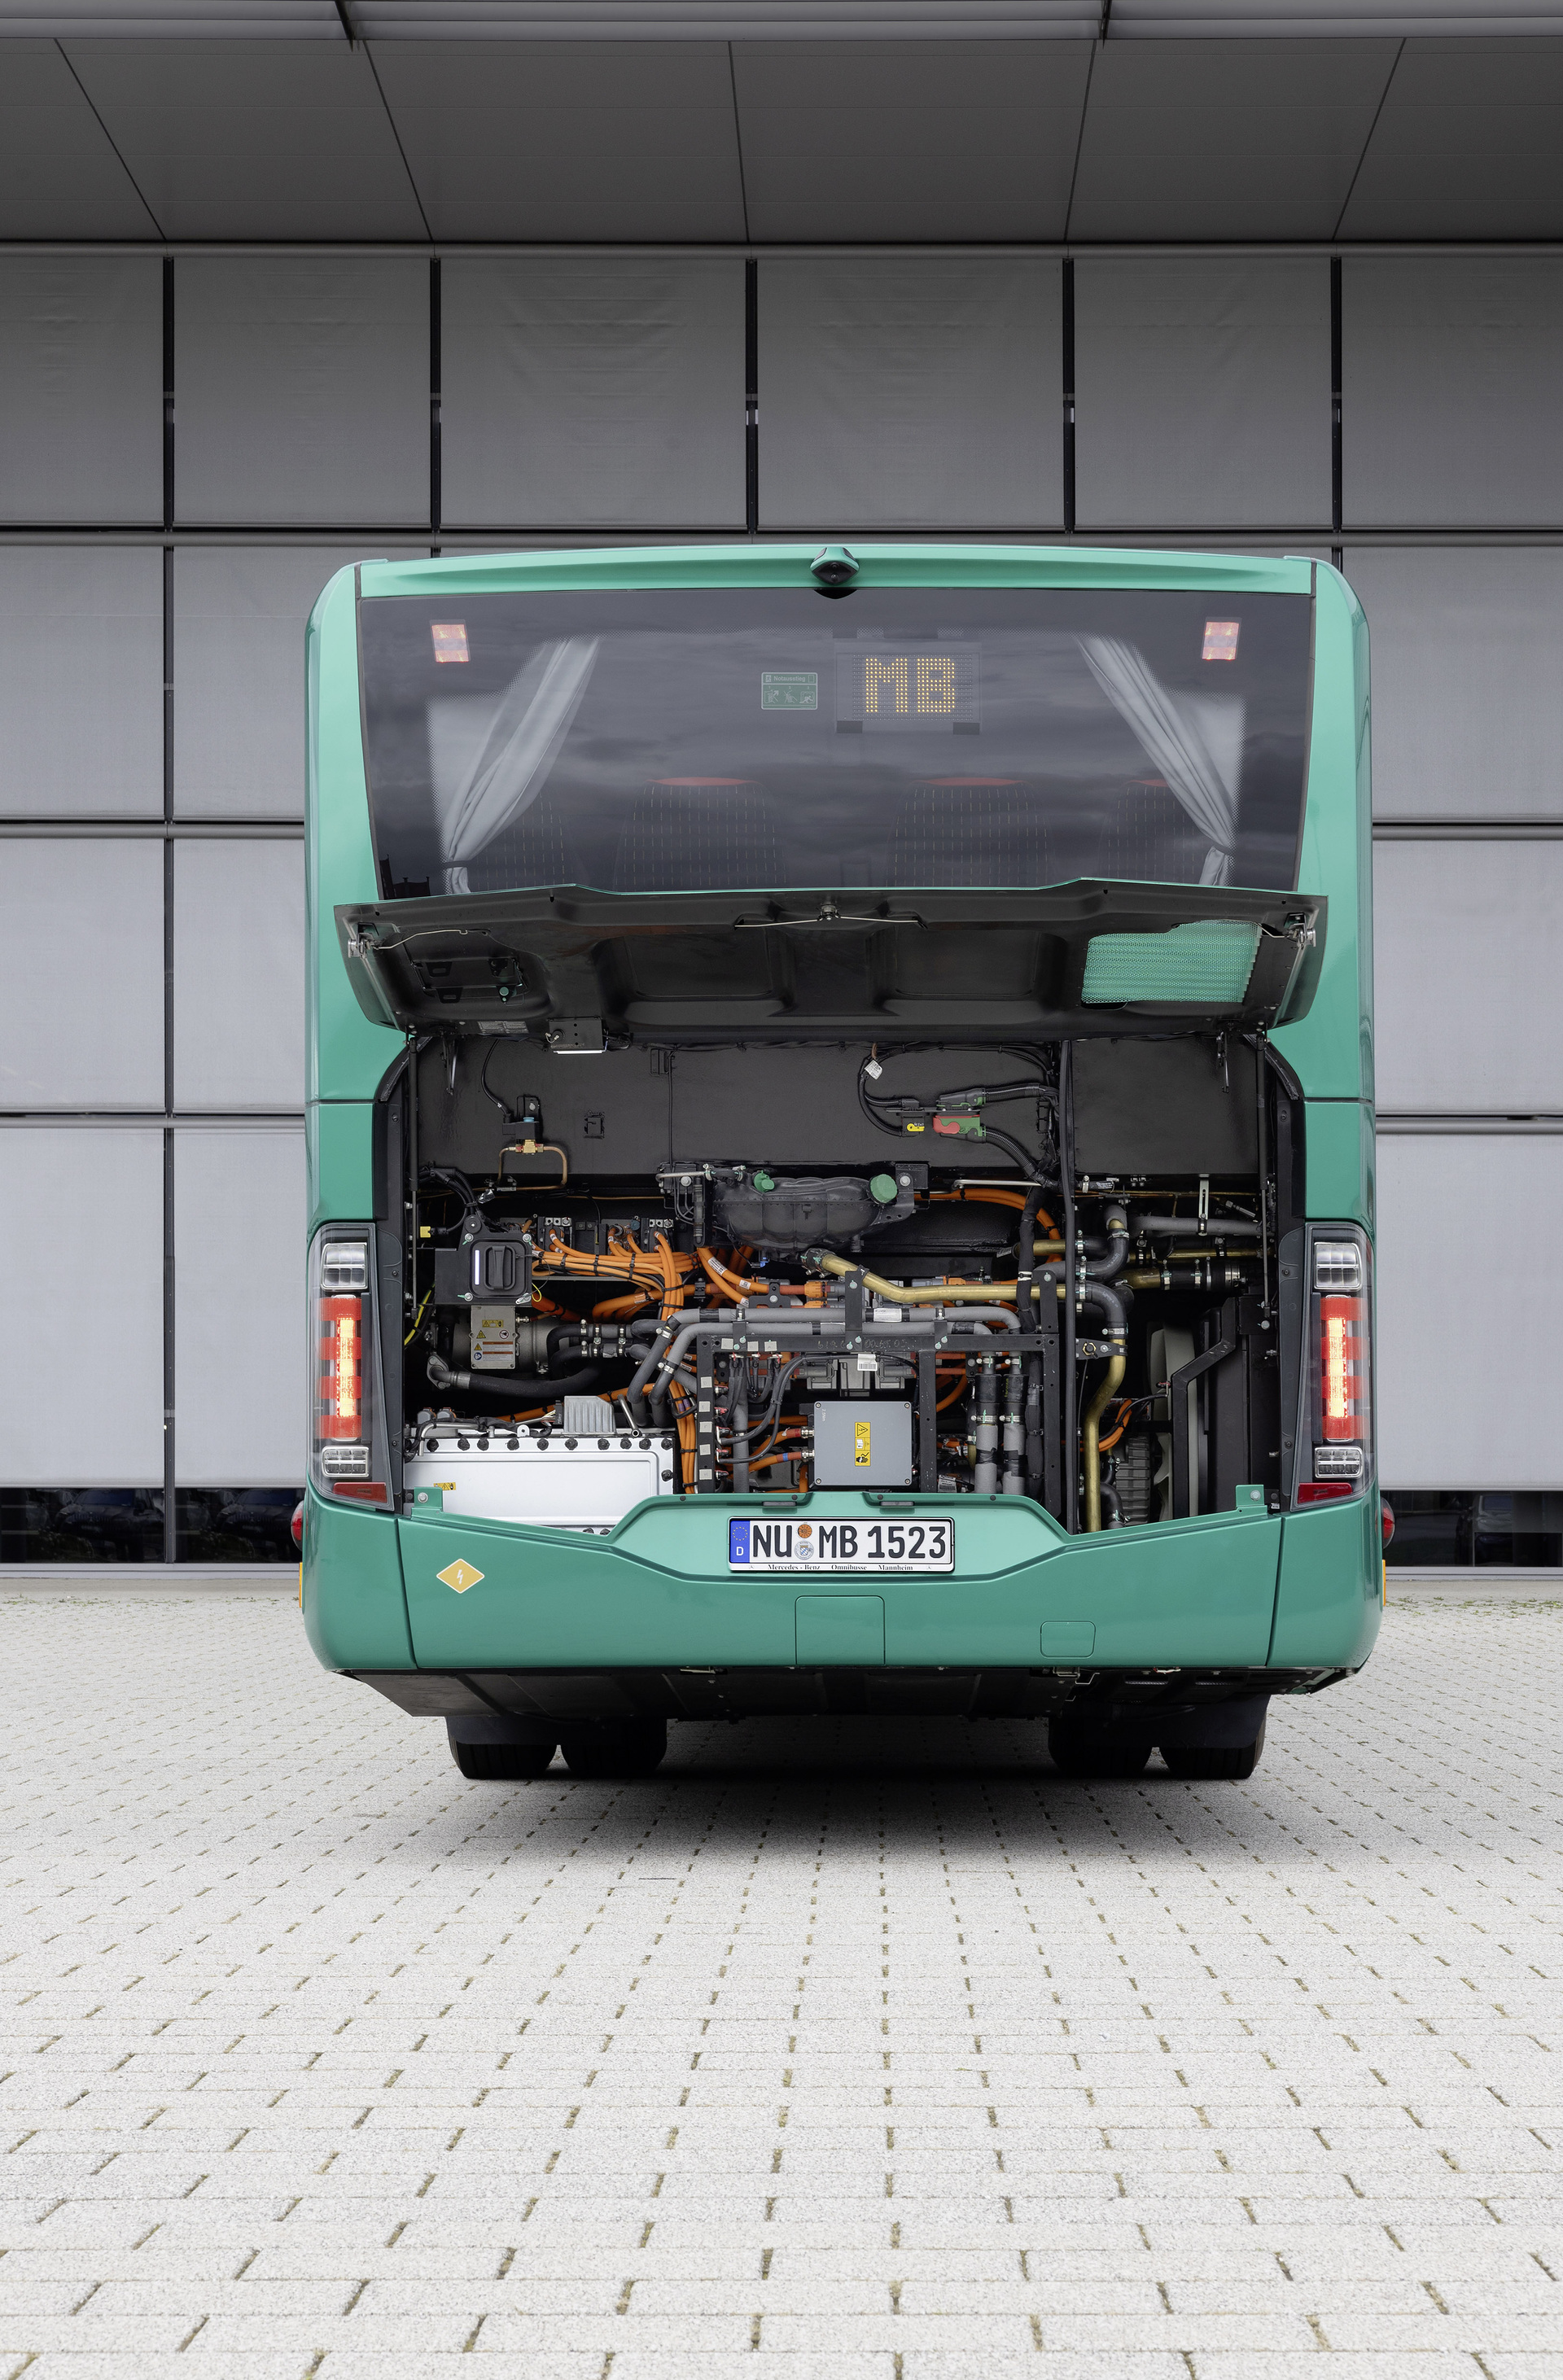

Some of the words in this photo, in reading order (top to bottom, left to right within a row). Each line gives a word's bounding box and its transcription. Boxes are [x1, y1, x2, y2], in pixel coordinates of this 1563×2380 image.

[865, 658, 956, 713] MB
[736, 1546, 744, 1556] D
[753, 1525, 792, 1558] NU
[819, 1525, 858, 1559] MB
[868, 1526, 946, 1559] 1523
